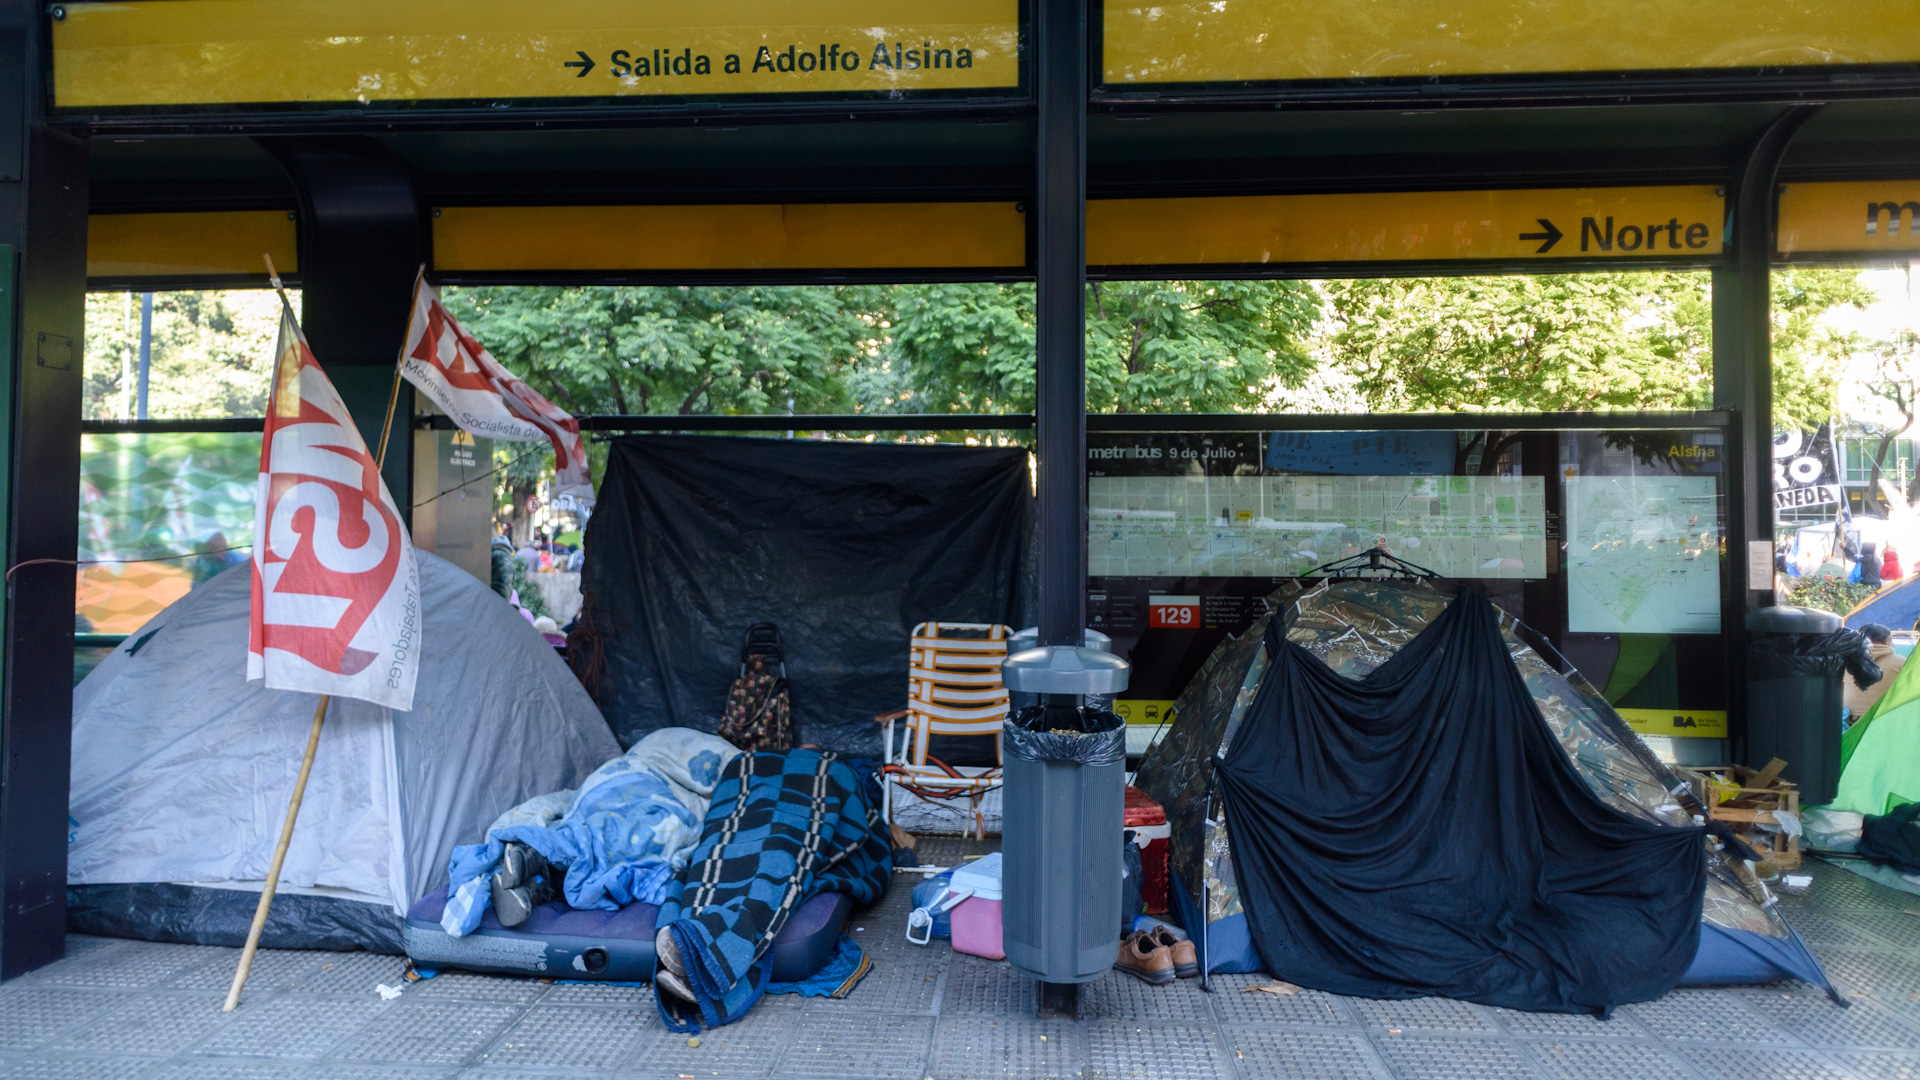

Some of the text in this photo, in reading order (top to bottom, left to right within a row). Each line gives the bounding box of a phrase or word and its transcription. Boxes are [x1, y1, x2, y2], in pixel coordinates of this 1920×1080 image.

[610, 42, 973, 78] Salida a Adolfo Alsina
[1580, 215, 1710, 252] Norte
[460, 412, 522, 437] Socialista
[524, 426, 540, 439] de
[1169, 447, 1178, 459] 9
[1181, 446, 1198, 459] de
[1202, 447, 1237, 459] Julio
[1668, 445, 1715, 457] Alsina
[1775, 486, 1835, 509] NEDA
[1157, 607, 1192, 624] 129
[1673, 716, 1697, 728] BA
